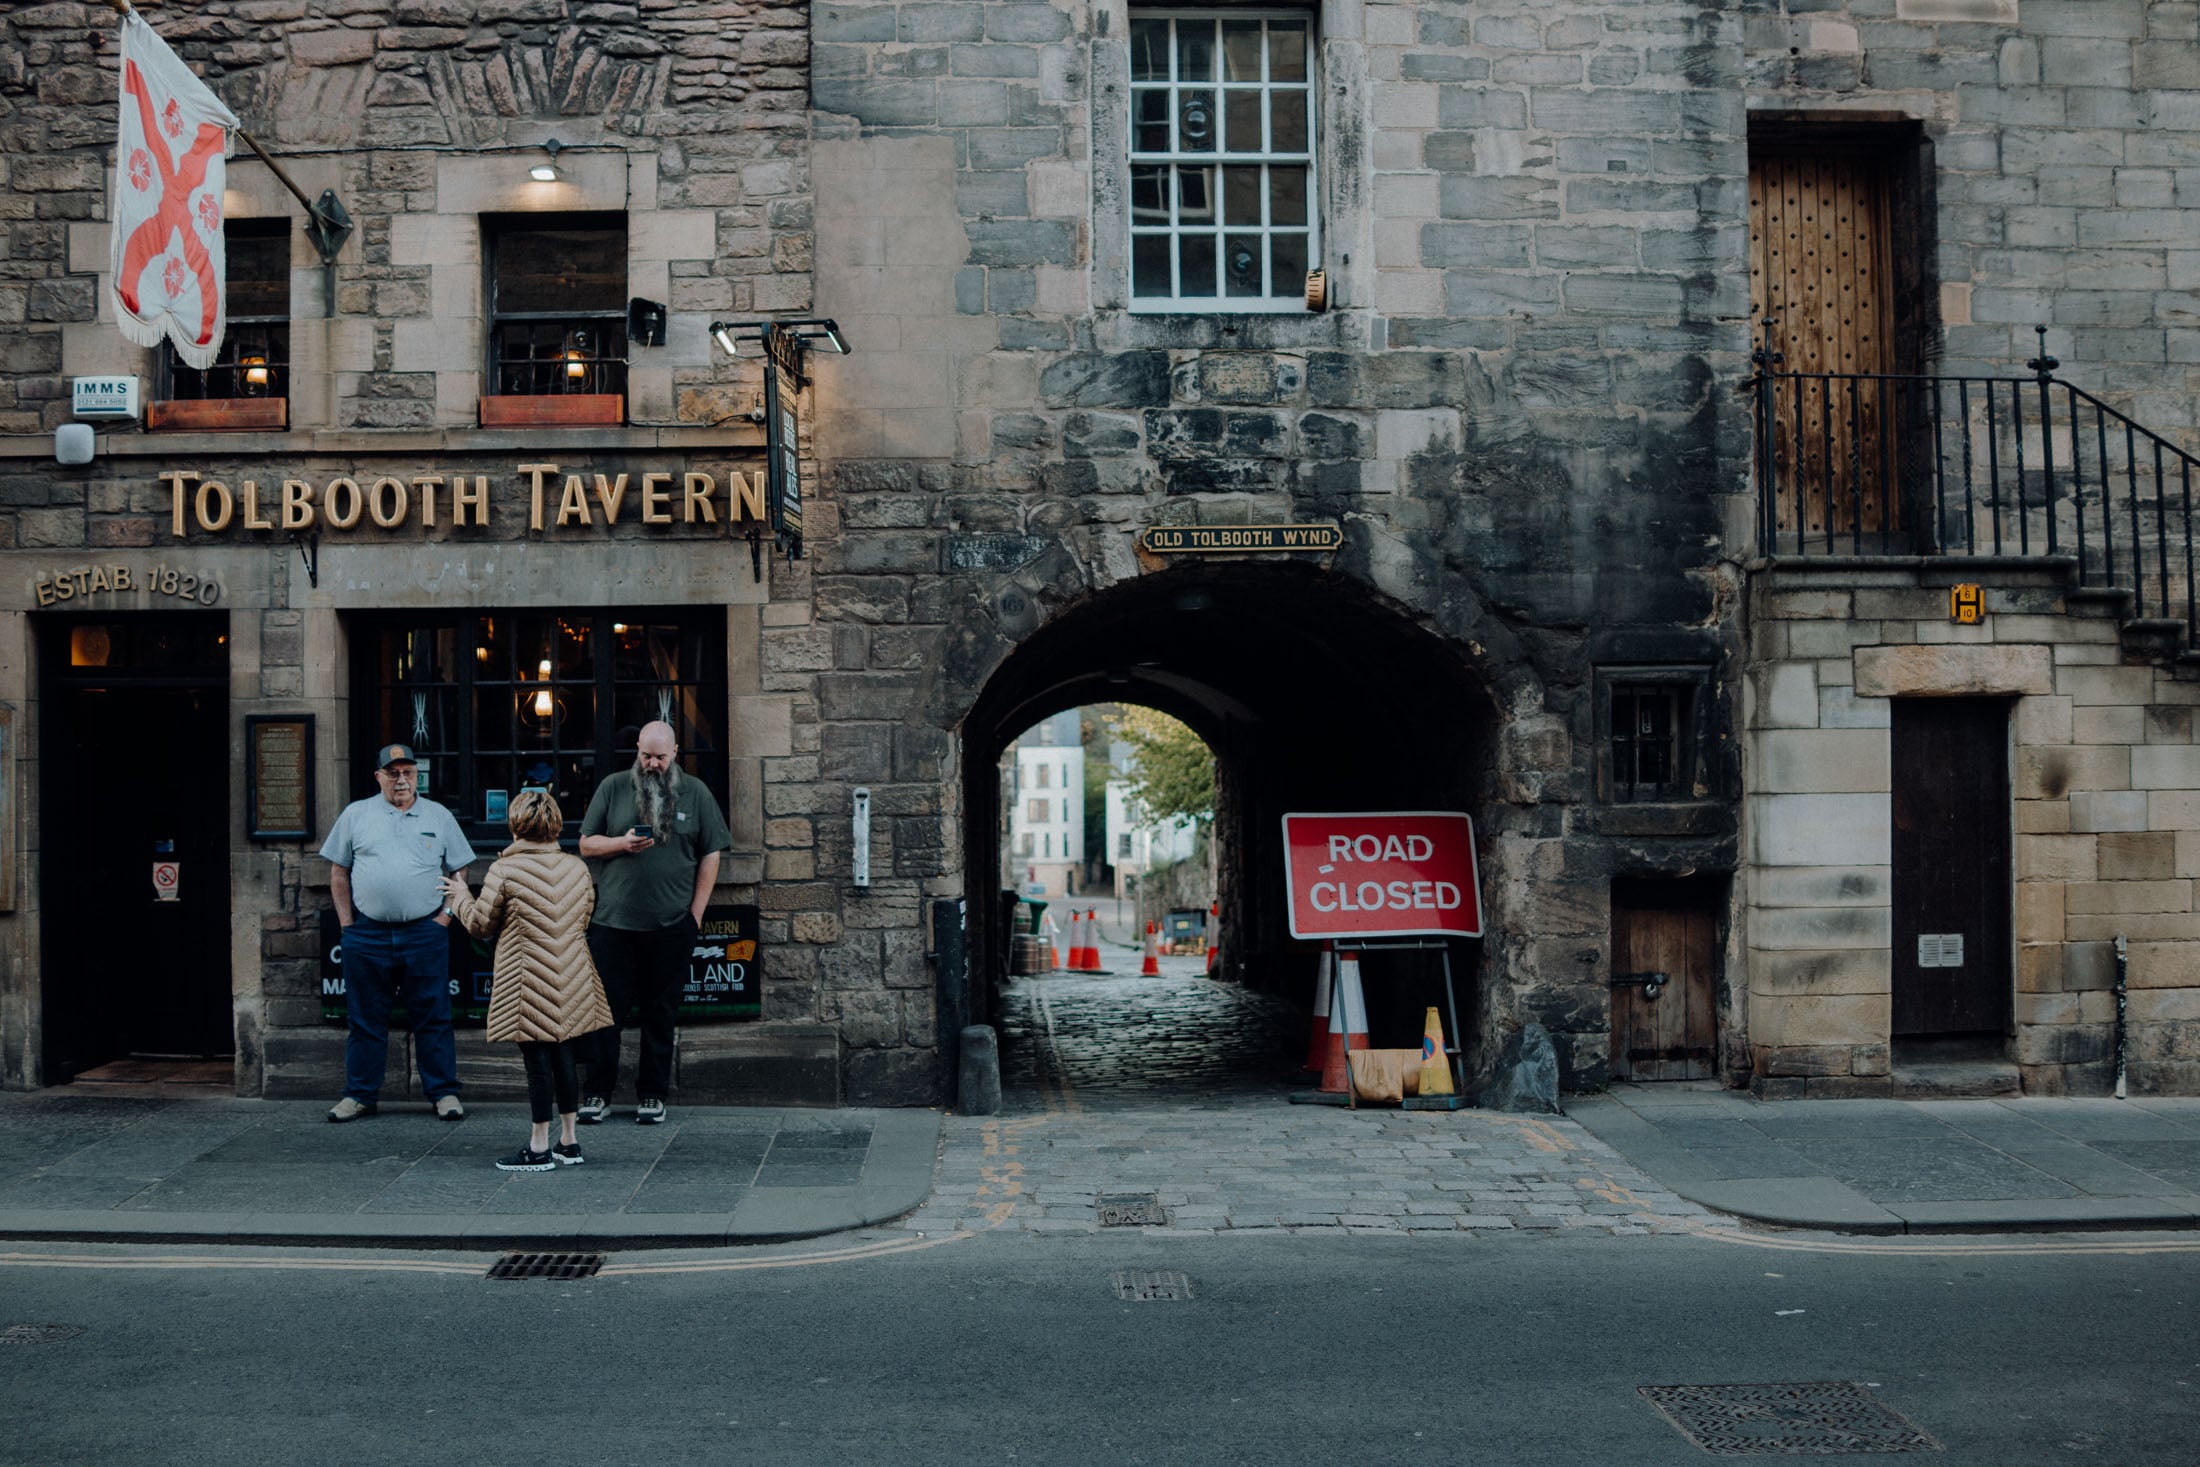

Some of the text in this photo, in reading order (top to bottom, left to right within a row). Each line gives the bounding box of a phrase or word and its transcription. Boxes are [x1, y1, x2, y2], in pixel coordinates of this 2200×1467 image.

[77, 383, 127, 394] IMMS
[159, 463, 766, 537] TOLBOOTH TAVERN
[1154, 530, 1331, 546] OLD TOLBOOTH WYND
[36, 565, 220, 607] ESTAB. 1820
[1964, 609, 1972, 617] 10
[1329, 834, 1434, 862] ROAD
[1310, 881, 1461, 912] CLOSED
